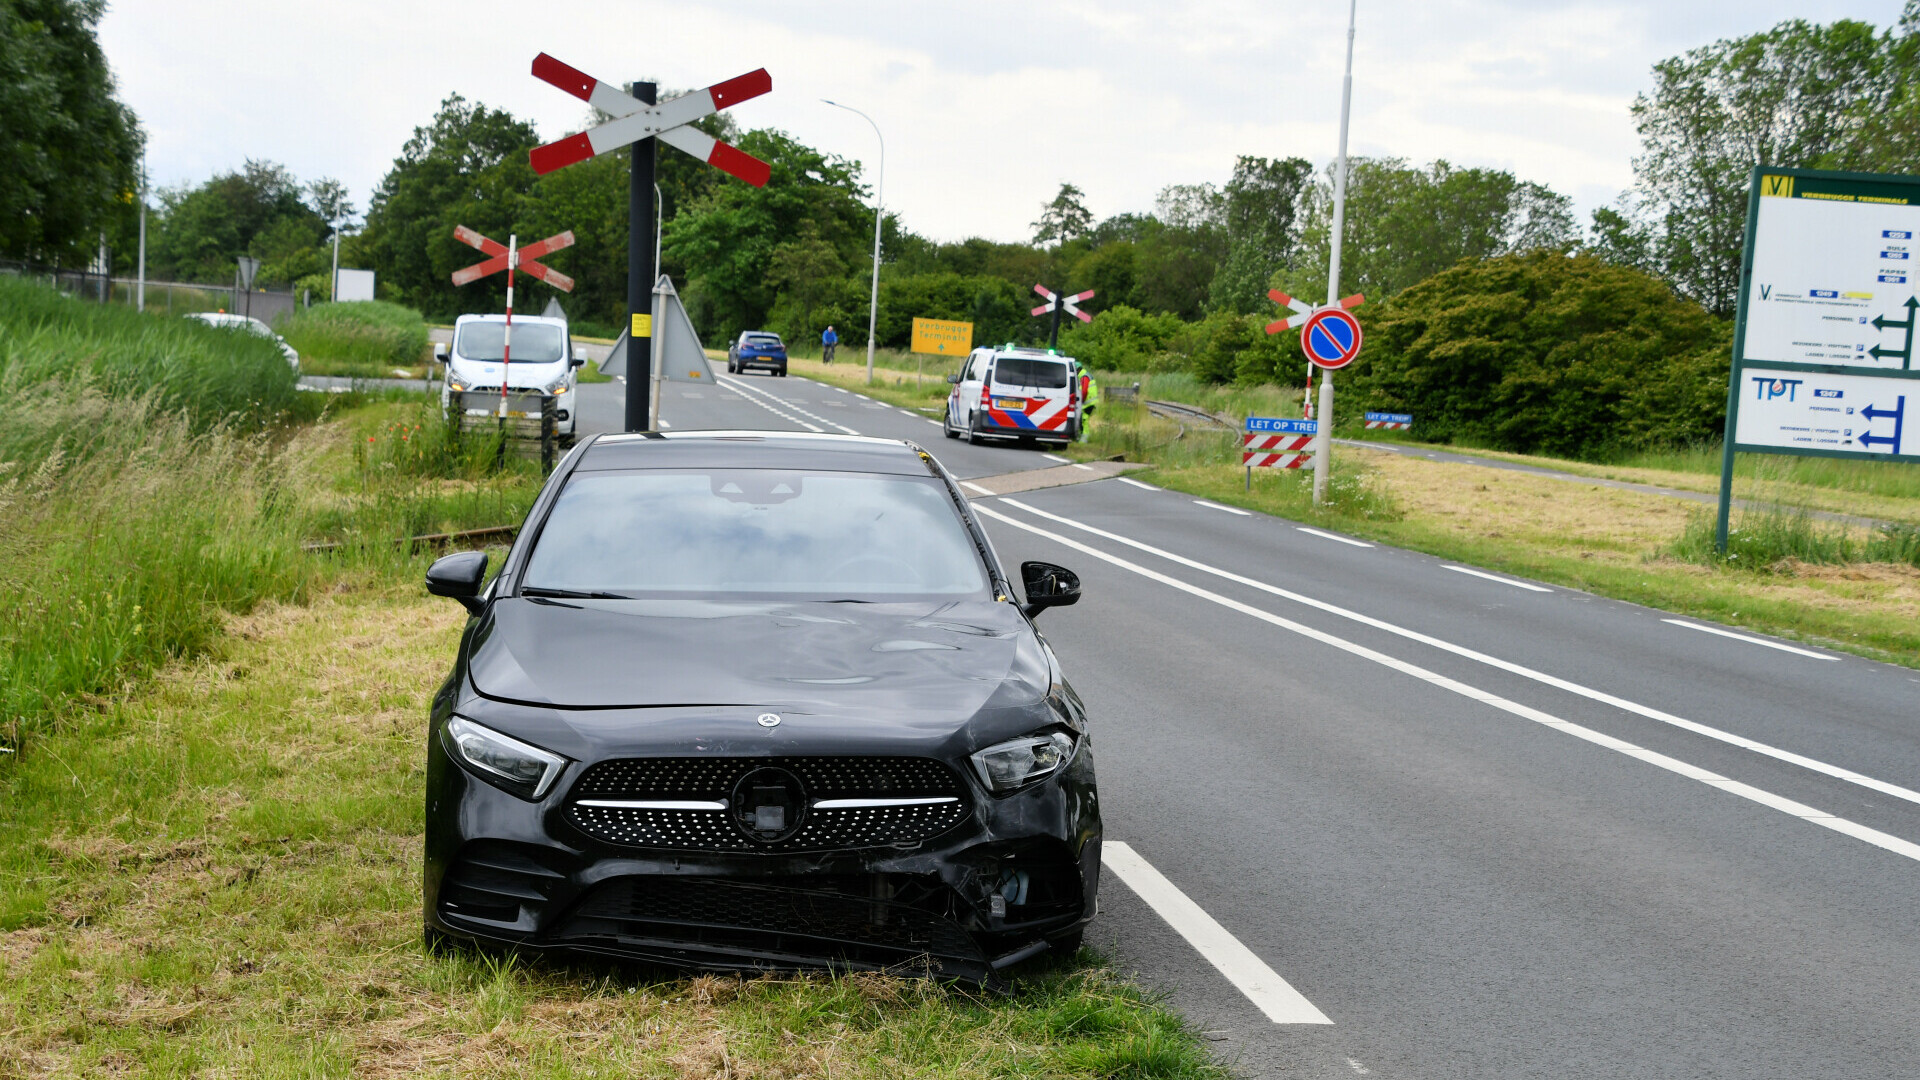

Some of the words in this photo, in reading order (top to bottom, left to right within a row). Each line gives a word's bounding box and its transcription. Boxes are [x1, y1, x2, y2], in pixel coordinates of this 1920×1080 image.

[1801, 192, 1856, 202] VERBRUGGE
[1857, 195, 1909, 205] TERMINALS
[919, 321, 968, 333] Verbrugge
[919, 330, 967, 342] Terminals
[1752, 377, 1803, 402] TPT
[1250, 420, 1268, 430] LET
[1273, 421, 1289, 430] OP
[1292, 422, 1318, 432] TREI
